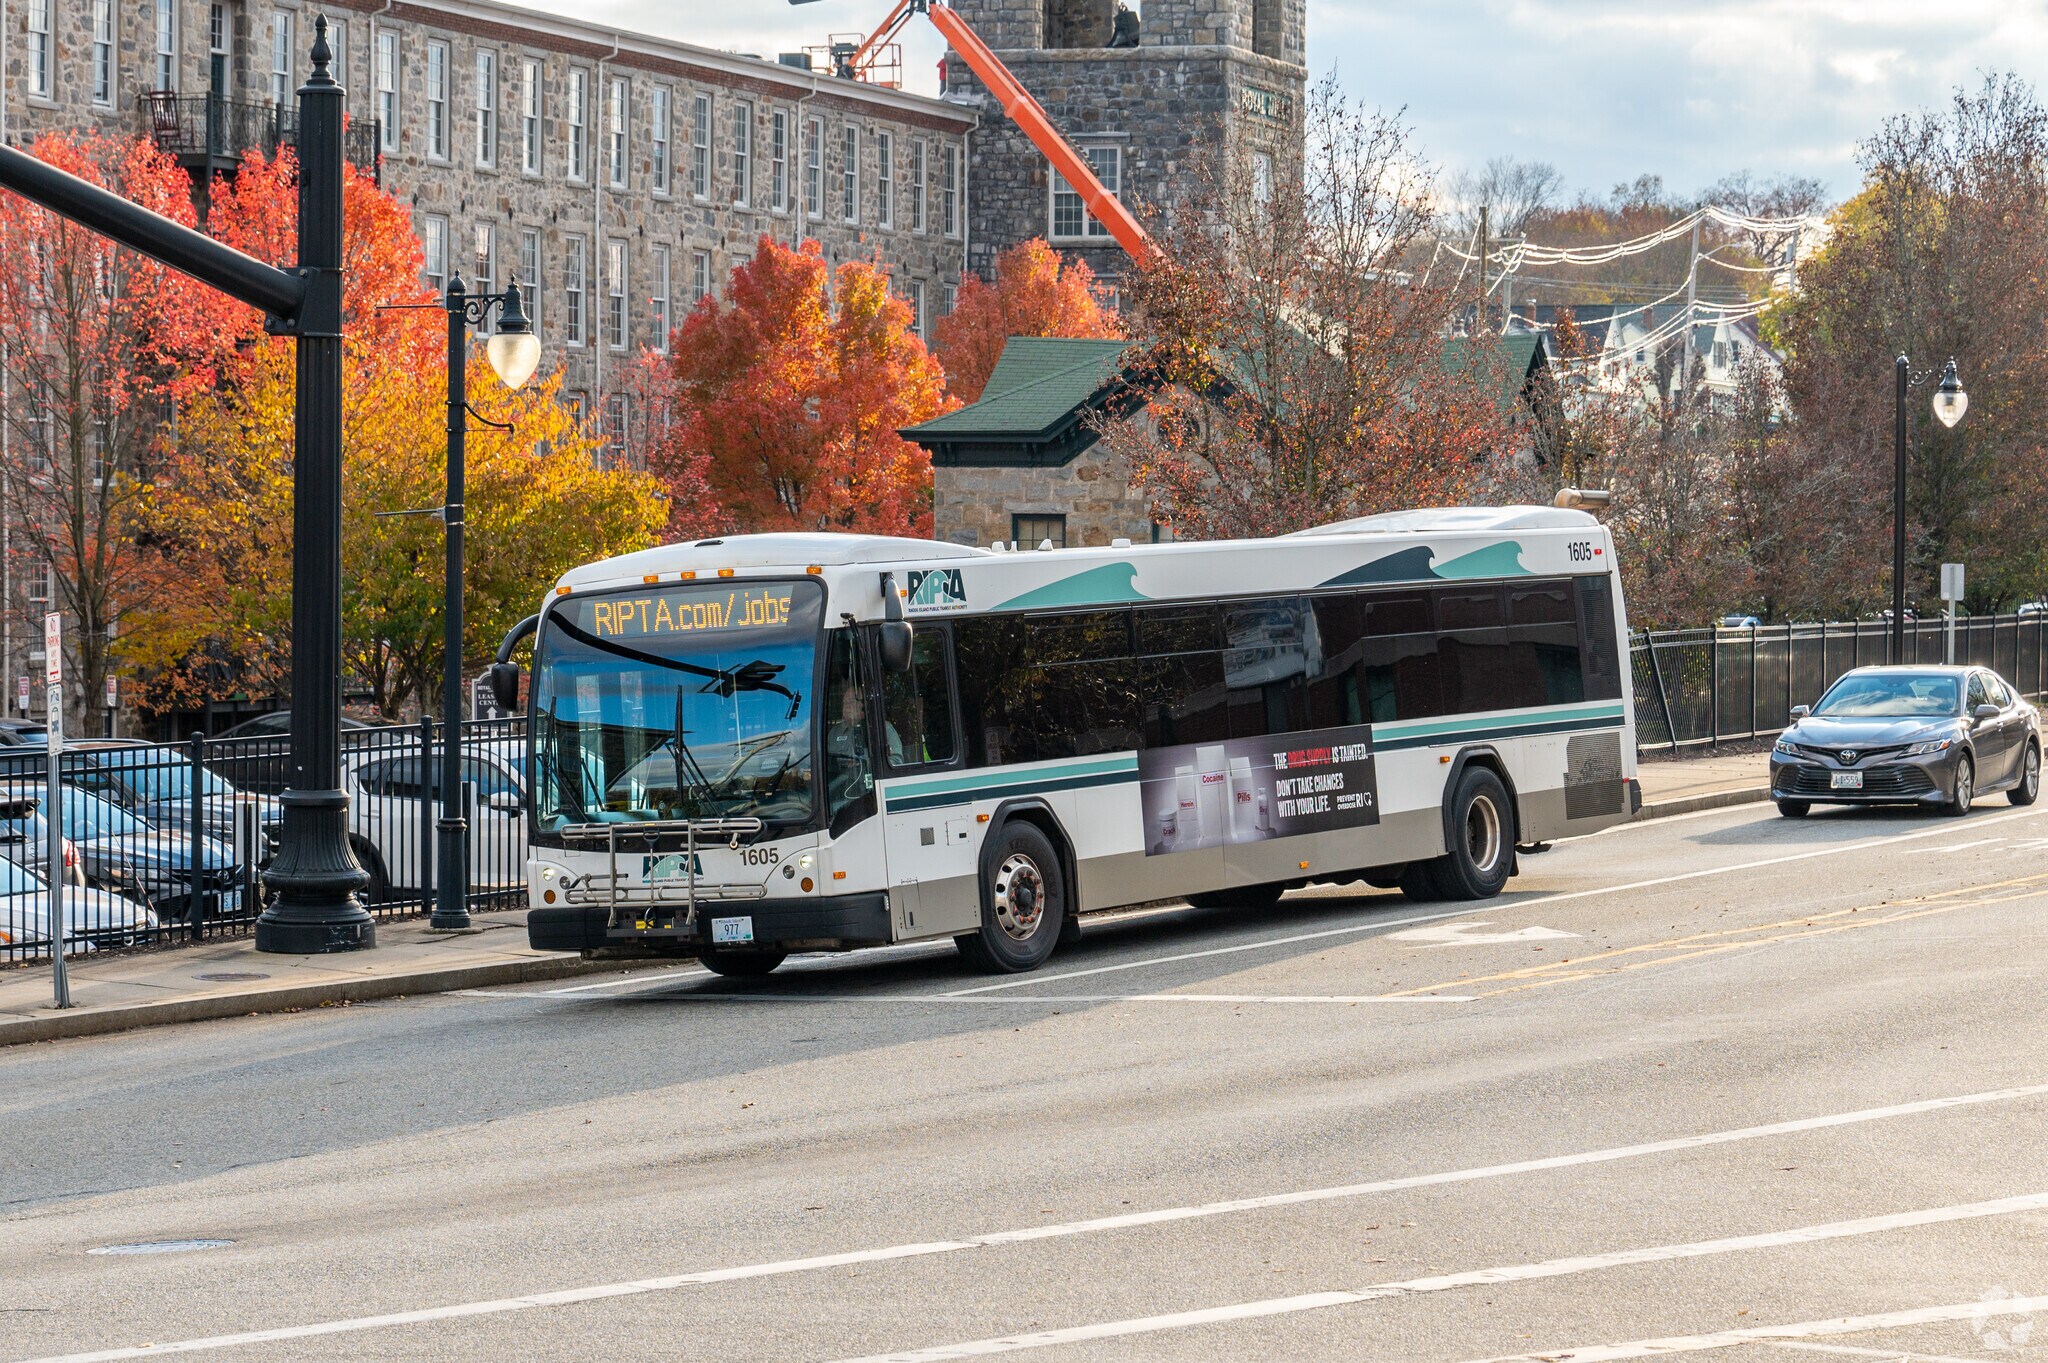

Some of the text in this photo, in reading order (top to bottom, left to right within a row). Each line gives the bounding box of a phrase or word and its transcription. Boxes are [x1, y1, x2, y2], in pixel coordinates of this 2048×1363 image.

[1241, 87, 1266, 115] ROYAL
[1567, 541, 1592, 561] 1605
[907, 568, 967, 605] RIPTA
[1273, 743, 1369, 770] THE DRUG SUPPLY IS TAINTED.
[1202, 773, 1224, 784] Cocaine
[1276, 772, 1344, 798] DON'T TAKE CHANCES
[1237, 792, 1251, 803] Pills
[1277, 795, 1331, 818] WITH YOUR LIFE.
[1336, 795, 1356, 803] PREVENT
[1337, 802, 1357, 810] OVERDOSE
[1356, 793, 1364, 808] RI
[1162, 827, 1176, 836] Crack
[642, 853, 704, 878] RIPTA
[739, 847, 779, 866] 1605
[724, 923, 739, 935] 977
